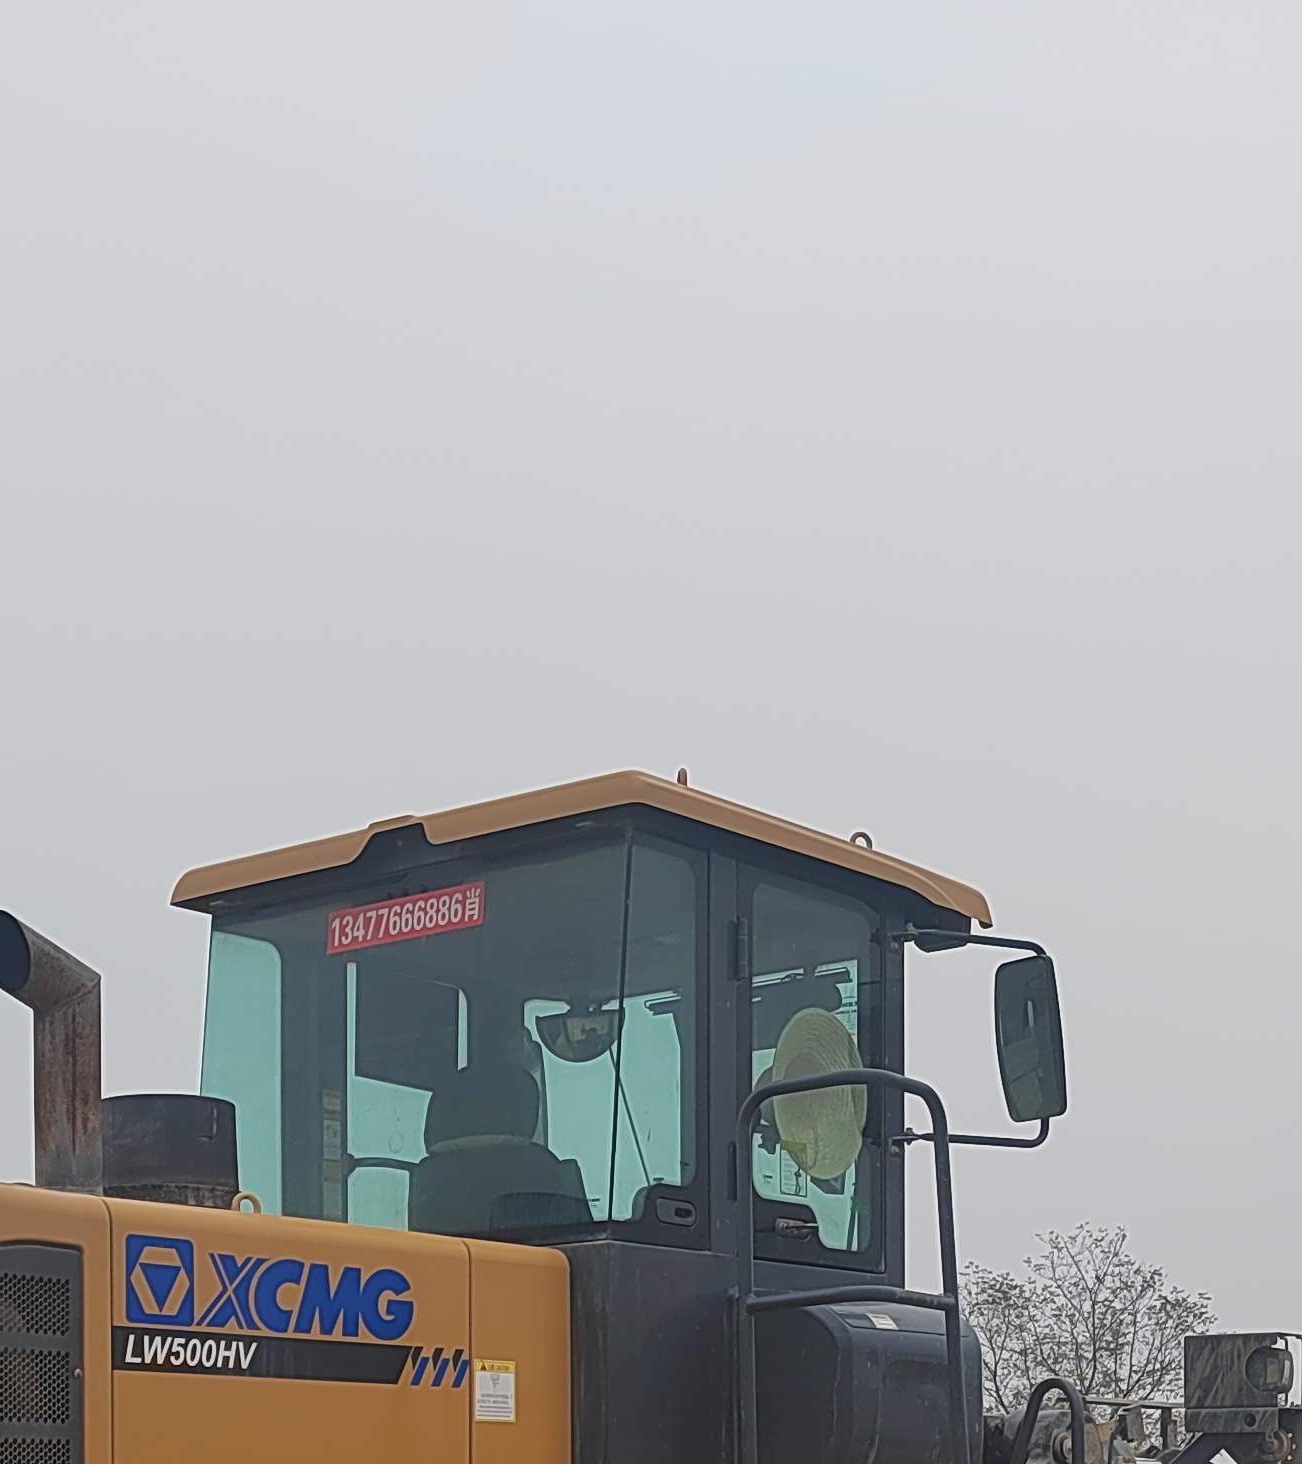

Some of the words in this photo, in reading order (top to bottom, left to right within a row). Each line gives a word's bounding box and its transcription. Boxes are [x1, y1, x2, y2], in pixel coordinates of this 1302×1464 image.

[332, 888, 481, 946] 13477666886肖
[195, 1252, 414, 1341] XCMG
[124, 1335, 257, 1370] LW500HV
